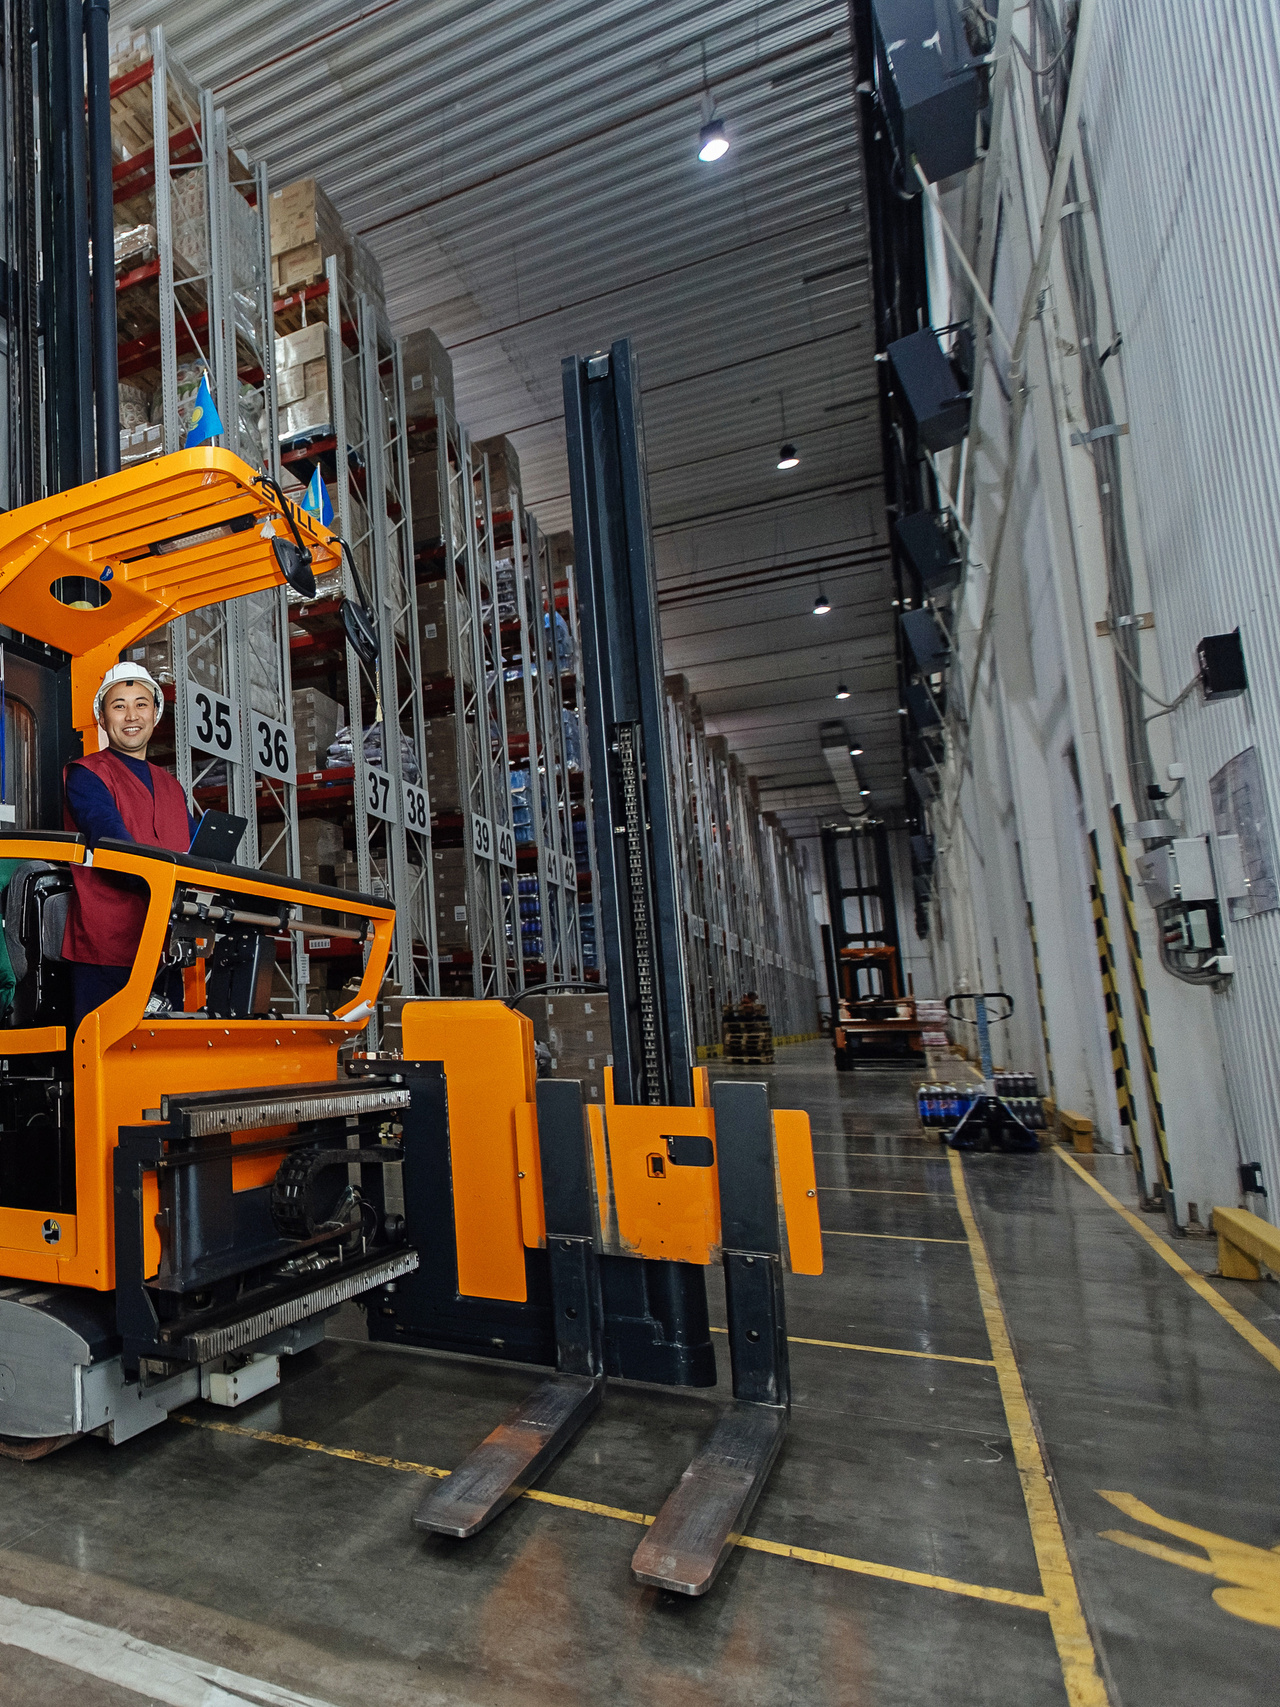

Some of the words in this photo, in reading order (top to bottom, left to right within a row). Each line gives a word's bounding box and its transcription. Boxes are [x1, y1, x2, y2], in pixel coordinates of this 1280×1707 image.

[195, 692, 233, 751] 35
[257, 721, 289, 775] 36
[368, 771, 390, 814] 37
[406, 788, 427, 829] 38
[475, 819, 490, 854] 39
[499, 831, 513, 863] 40
[547, 852, 558, 880] 41
[564, 860, 575, 887] 42
